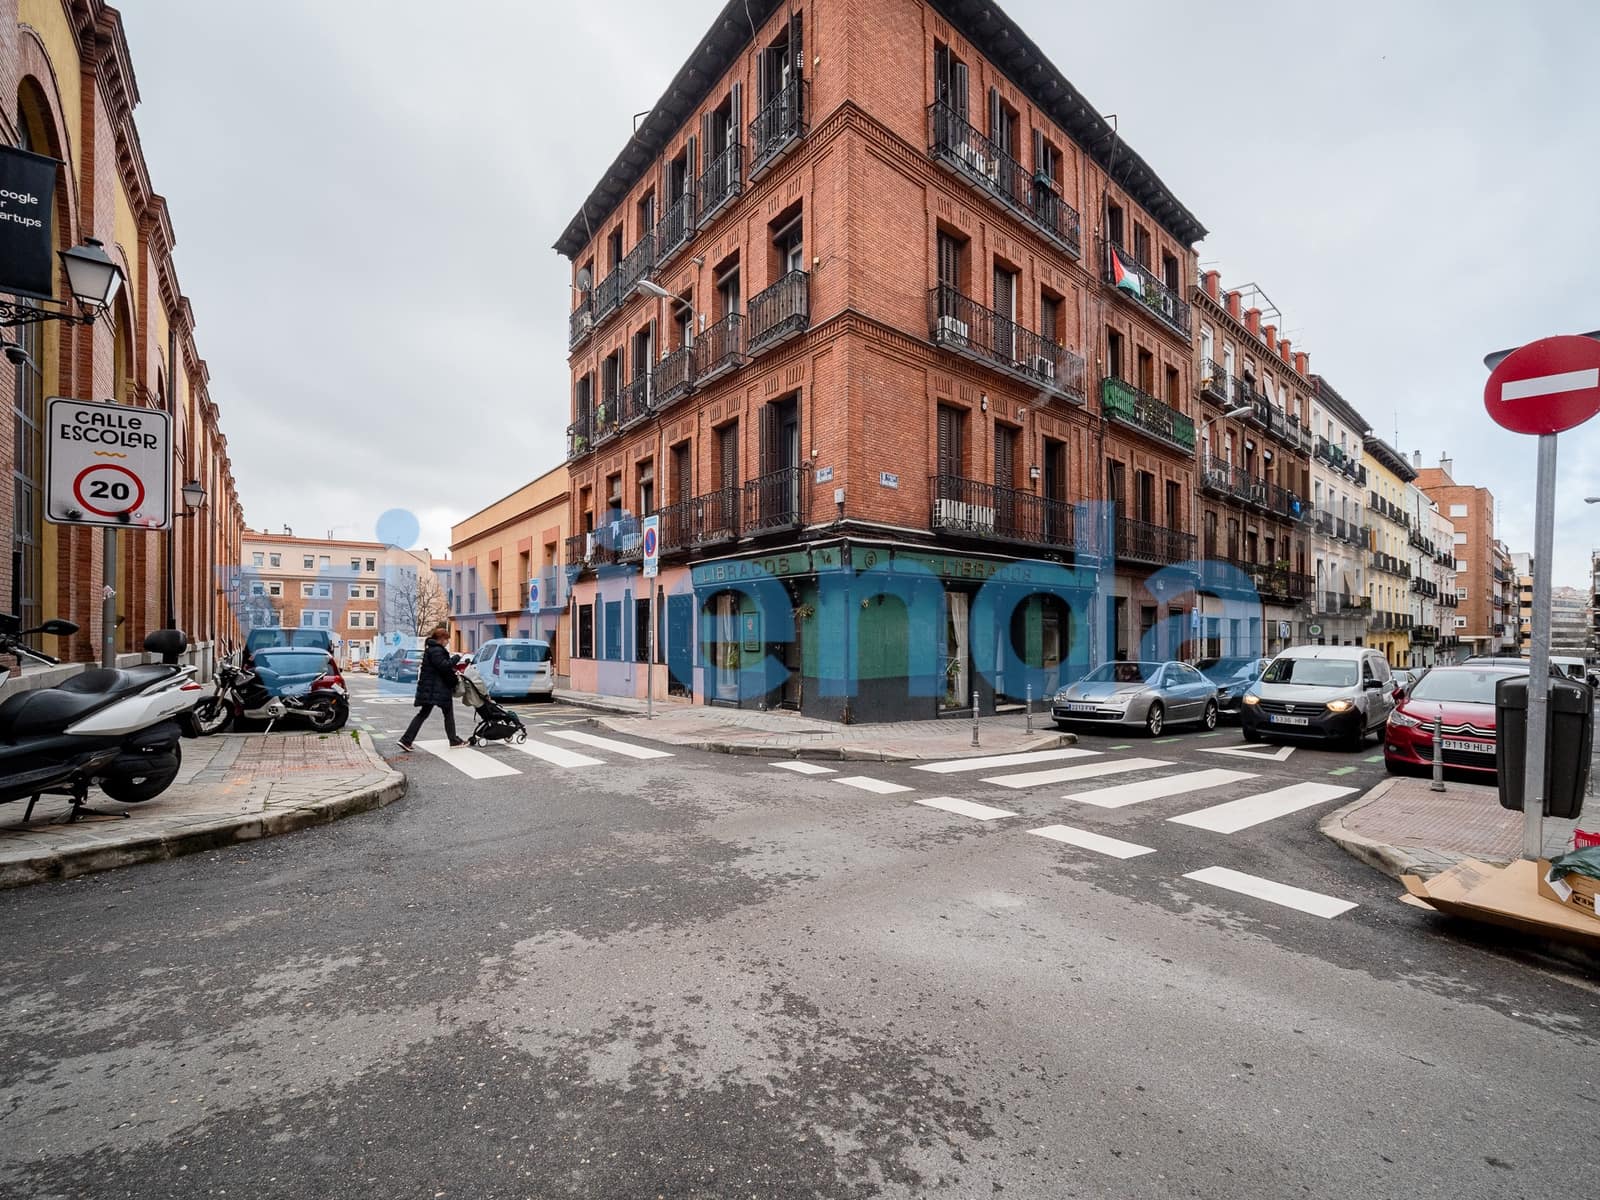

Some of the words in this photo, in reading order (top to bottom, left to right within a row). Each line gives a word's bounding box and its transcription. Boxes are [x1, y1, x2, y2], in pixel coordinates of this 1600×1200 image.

[60, 423, 157, 450] ESCOLAR
[89, 480, 130, 501] 20
[1445, 740, 1470, 750] 9119
[1473, 743, 1493, 752] HLP
